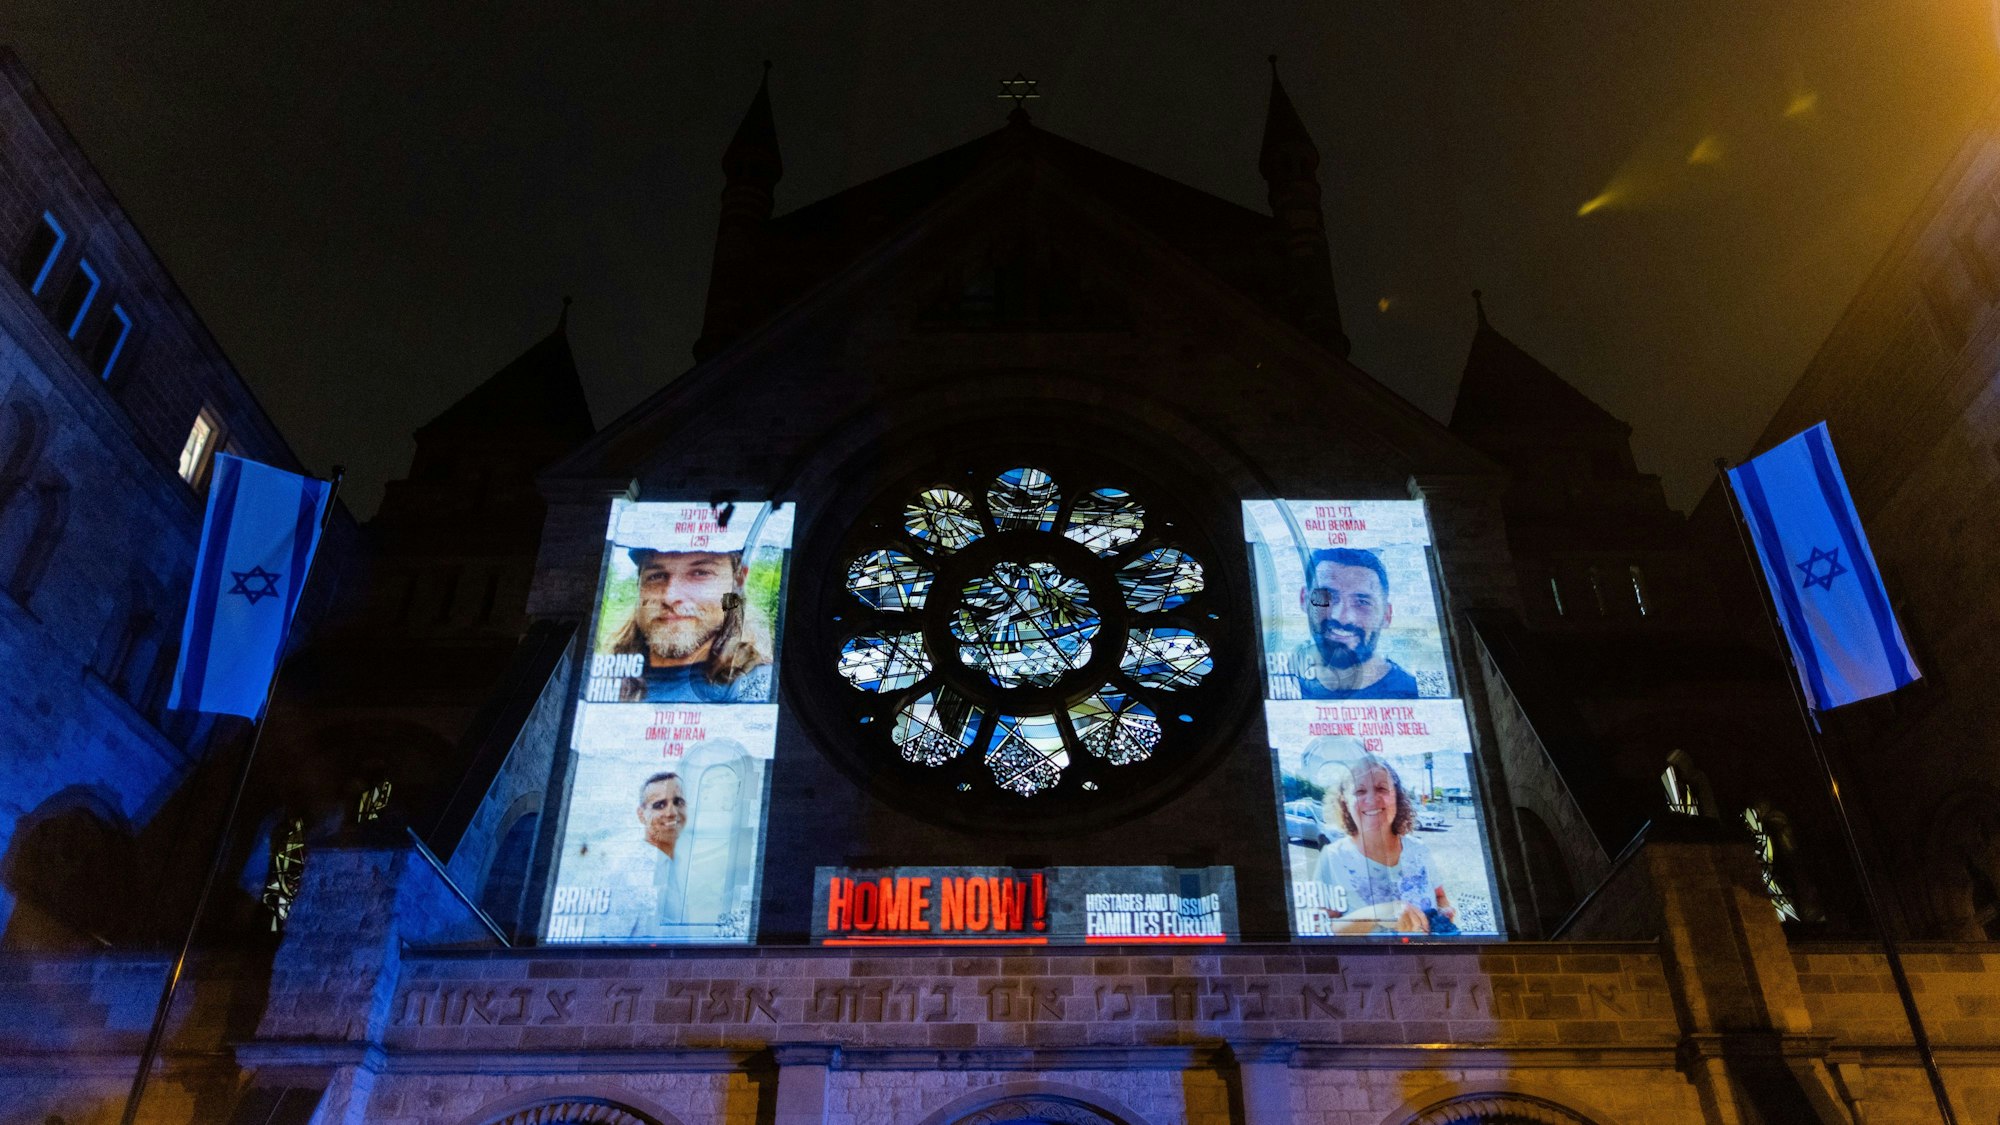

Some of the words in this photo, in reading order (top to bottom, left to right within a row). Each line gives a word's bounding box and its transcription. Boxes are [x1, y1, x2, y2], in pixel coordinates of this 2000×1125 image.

[674, 522, 696, 534] RONI
[1305, 519, 1326, 531] GALI
[1328, 519, 1366, 531] BERMAN
[690, 535, 709, 548] (25)
[590, 652, 645, 678] BRING
[586, 676, 622, 702] HIM
[1269, 674, 1303, 700] HIM
[645, 727, 670, 740] OMRI
[673, 727, 706, 740] MIRAN
[1309, 722, 1356, 736] ADRIENNE
[1358, 722, 1394, 737] (AVIVA)
[1397, 722, 1431, 736] SIEGEL
[1364, 738, 1383, 753] (62)
[553, 886, 612, 915] BRING
[827, 876, 931, 931] HOME
[941, 873, 1048, 931] NOW!
[1086, 893, 1143, 912] HOSTAGES
[1145, 893, 1168, 912] AND
[1169, 893, 1220, 916] MISSING
[1293, 880, 1349, 912] BRING
[547, 914, 587, 943] HIM
[1086, 911, 1160, 937] FAMILIES
[1162, 911, 1222, 937] FORUM
[1297, 908, 1334, 936] HER
